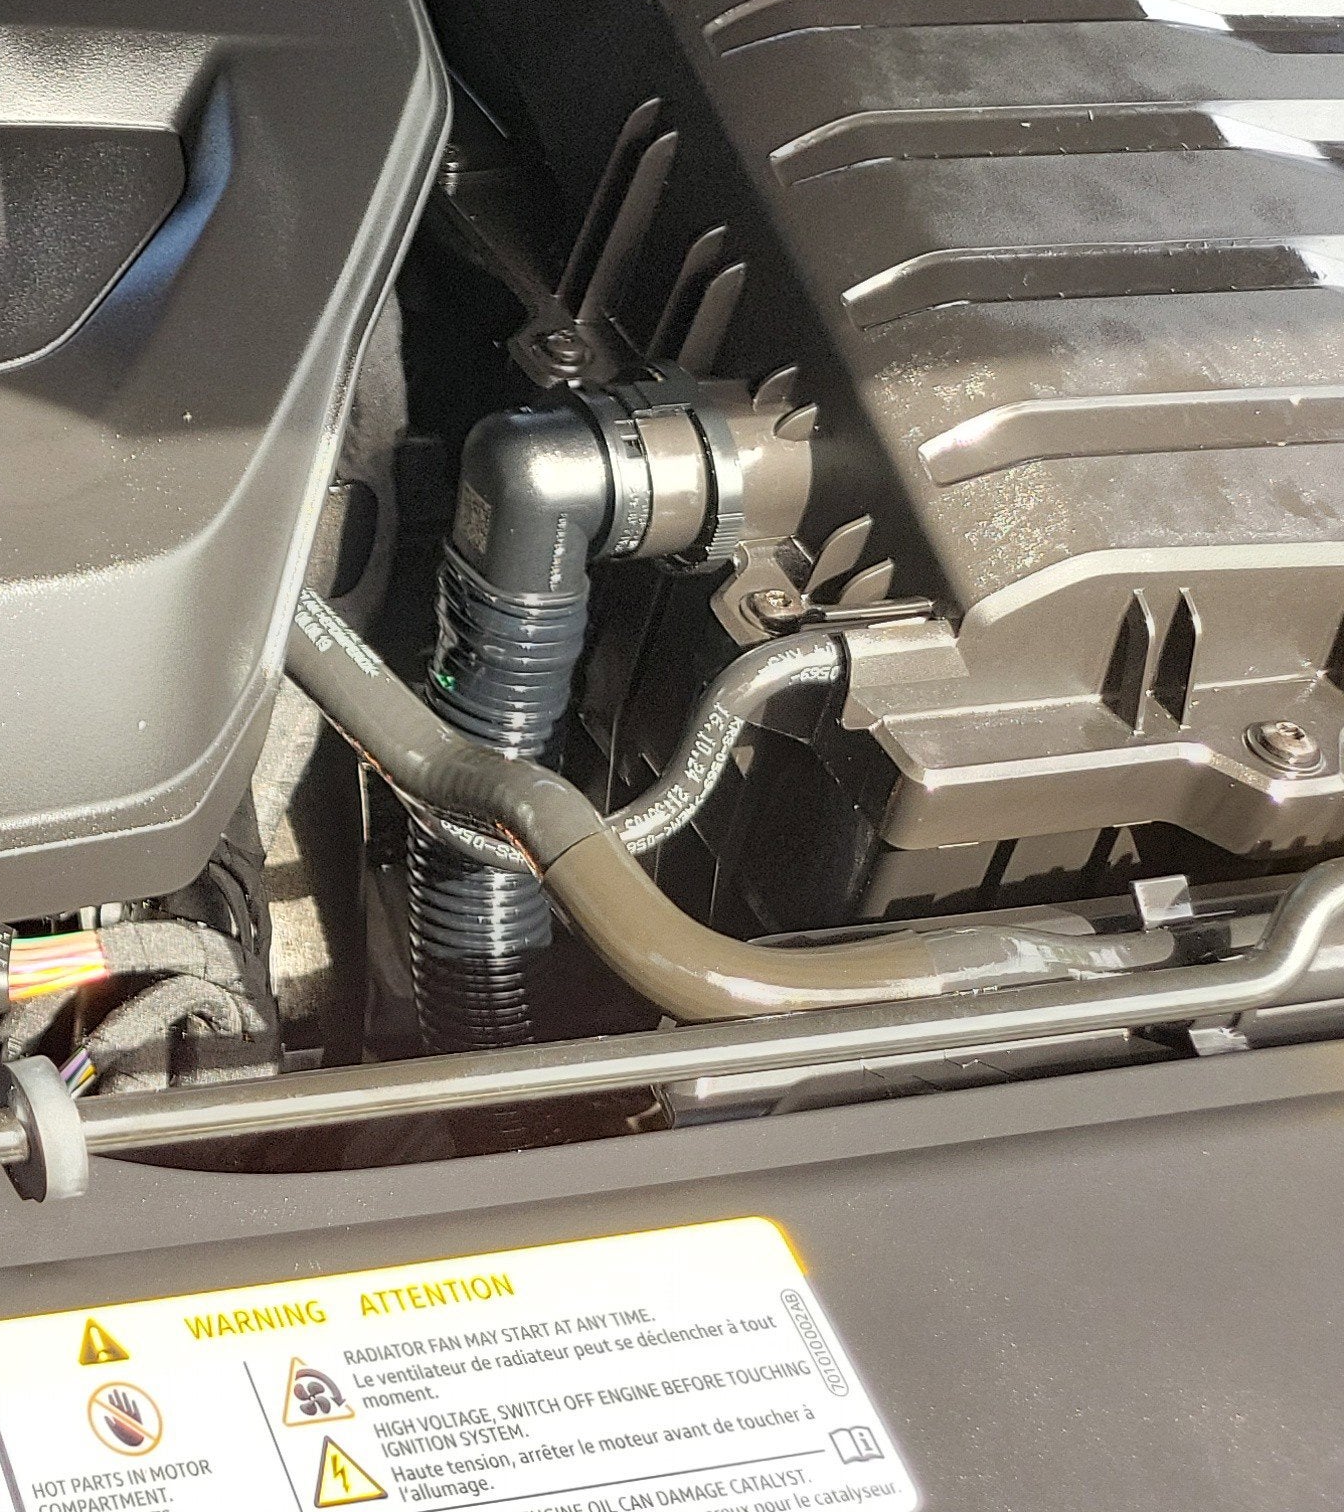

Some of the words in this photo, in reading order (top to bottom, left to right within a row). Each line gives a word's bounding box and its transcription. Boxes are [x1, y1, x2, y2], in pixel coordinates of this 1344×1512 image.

[184, 1300, 328, 1340] WARNING
[359, 1273, 515, 1317] ATTENTION
[343, 1340, 427, 1366] RADIATOR
[430, 1335, 462, 1354] FAN
[464, 1329, 498, 1349] MAY
[500, 1322, 551, 1343] START
[554, 1318, 575, 1335] AT
[577, 1313, 610, 1332] ANY
[610, 1308, 657, 1327] TIME.
[352, 1371, 375, 1389] Le
[377, 1357, 467, 1385] ventilateur
[471, 1356, 492, 1373] de
[495, 1344, 572, 1369] radiateur
[573, 1337, 614, 1360] peut
[614, 1337, 634, 1352] se
[636, 1322, 724, 1348] déclencher
[727, 1318, 739, 1335] à
[740, 1314, 778, 1332] tout
[362, 1385, 440, 1409] moment.
[373, 1416, 419, 1439] HIGH
[420, 1407, 498, 1433] VOLTAGE,
[497, 1397, 562, 1421] SWITCH
[563, 1390, 596, 1411] OFF
[599, 1383, 663, 1406] ENGINE
[660, 1371, 727, 1396] BEFORE
[726, 1359, 812, 1386] TOUCHING
[380, 1434, 458, 1459] IGNITION
[461, 1423, 531, 1448] SYSTEM.
[390, 1463, 445, 1483] Haute
[446, 1452, 517, 1476] tension,
[518, 1444, 576, 1465] arrêter
[578, 1437, 596, 1456] le
[598, 1430, 660, 1452] moteur
[662, 1418, 711, 1442] avant
[712, 1416, 736, 1434] de
[736, 1406, 800, 1430] toucher
[802, 1403, 816, 1421] à
[31, 1479, 67, 1500] HOT
[70, 1472, 125, 1494] PARTS
[126, 1467, 148, 1486] IN
[148, 1459, 213, 1482] MOTOR
[398, 1477, 496, 1504] l'allumage.
[618, 1492, 655, 1512] CAN
[655, 1481, 729, 1507] DAMAGE
[728, 1468, 813, 1495] CATALYST.
[792, 1491, 812, 1509] le
[813, 1480, 904, 1507] catalyseur.
